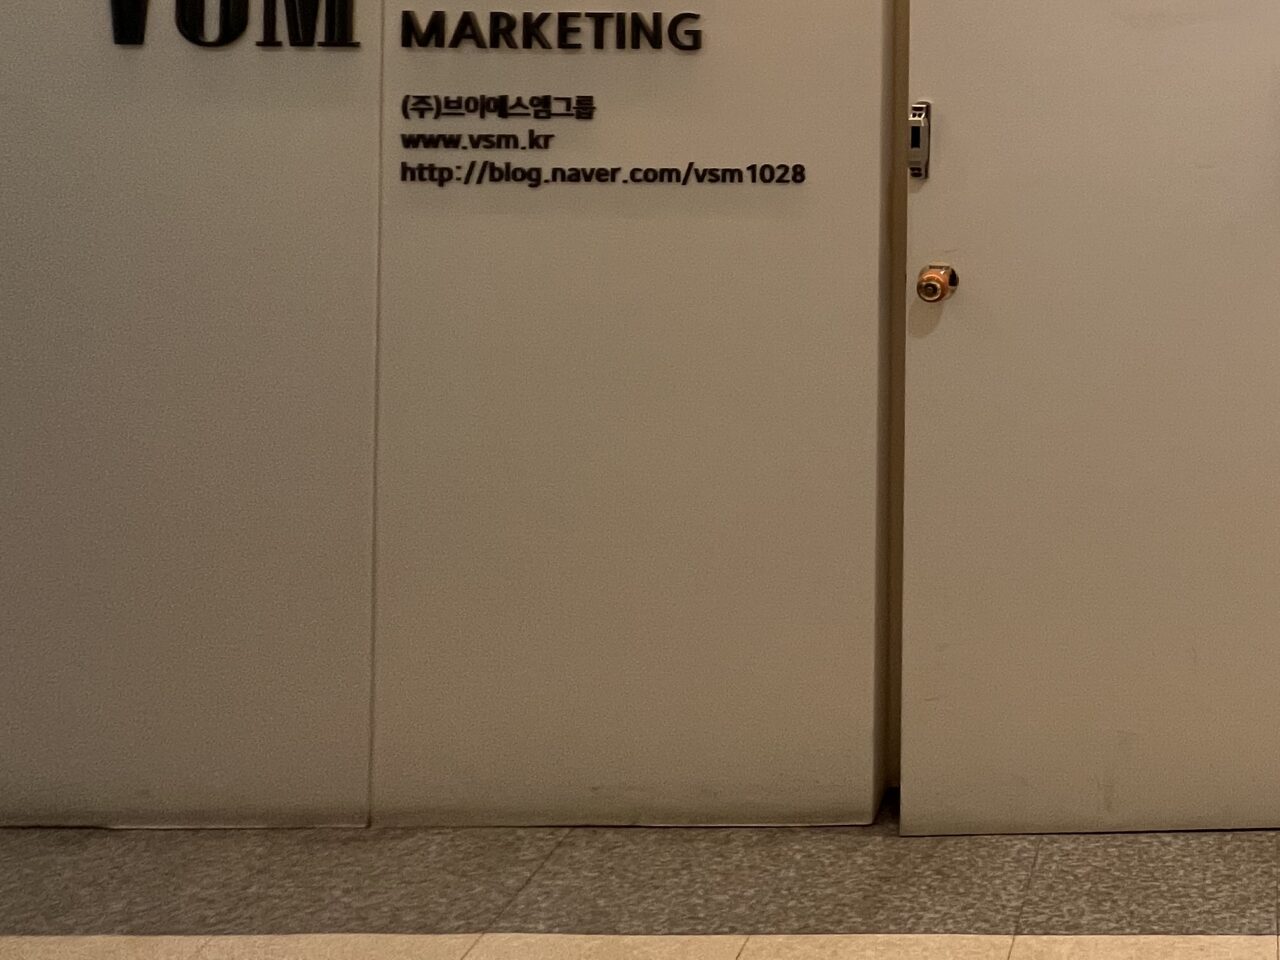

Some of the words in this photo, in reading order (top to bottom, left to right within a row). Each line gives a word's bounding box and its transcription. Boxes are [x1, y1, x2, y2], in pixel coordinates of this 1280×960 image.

[401, 11, 703, 51] MARKETING
[401, 94, 596, 120] (주)브이에스엠그룹
[400, 129, 555, 150] www.vsm.kr
[400, 161, 806, 187] http://blog.naver.com/vsm1028
